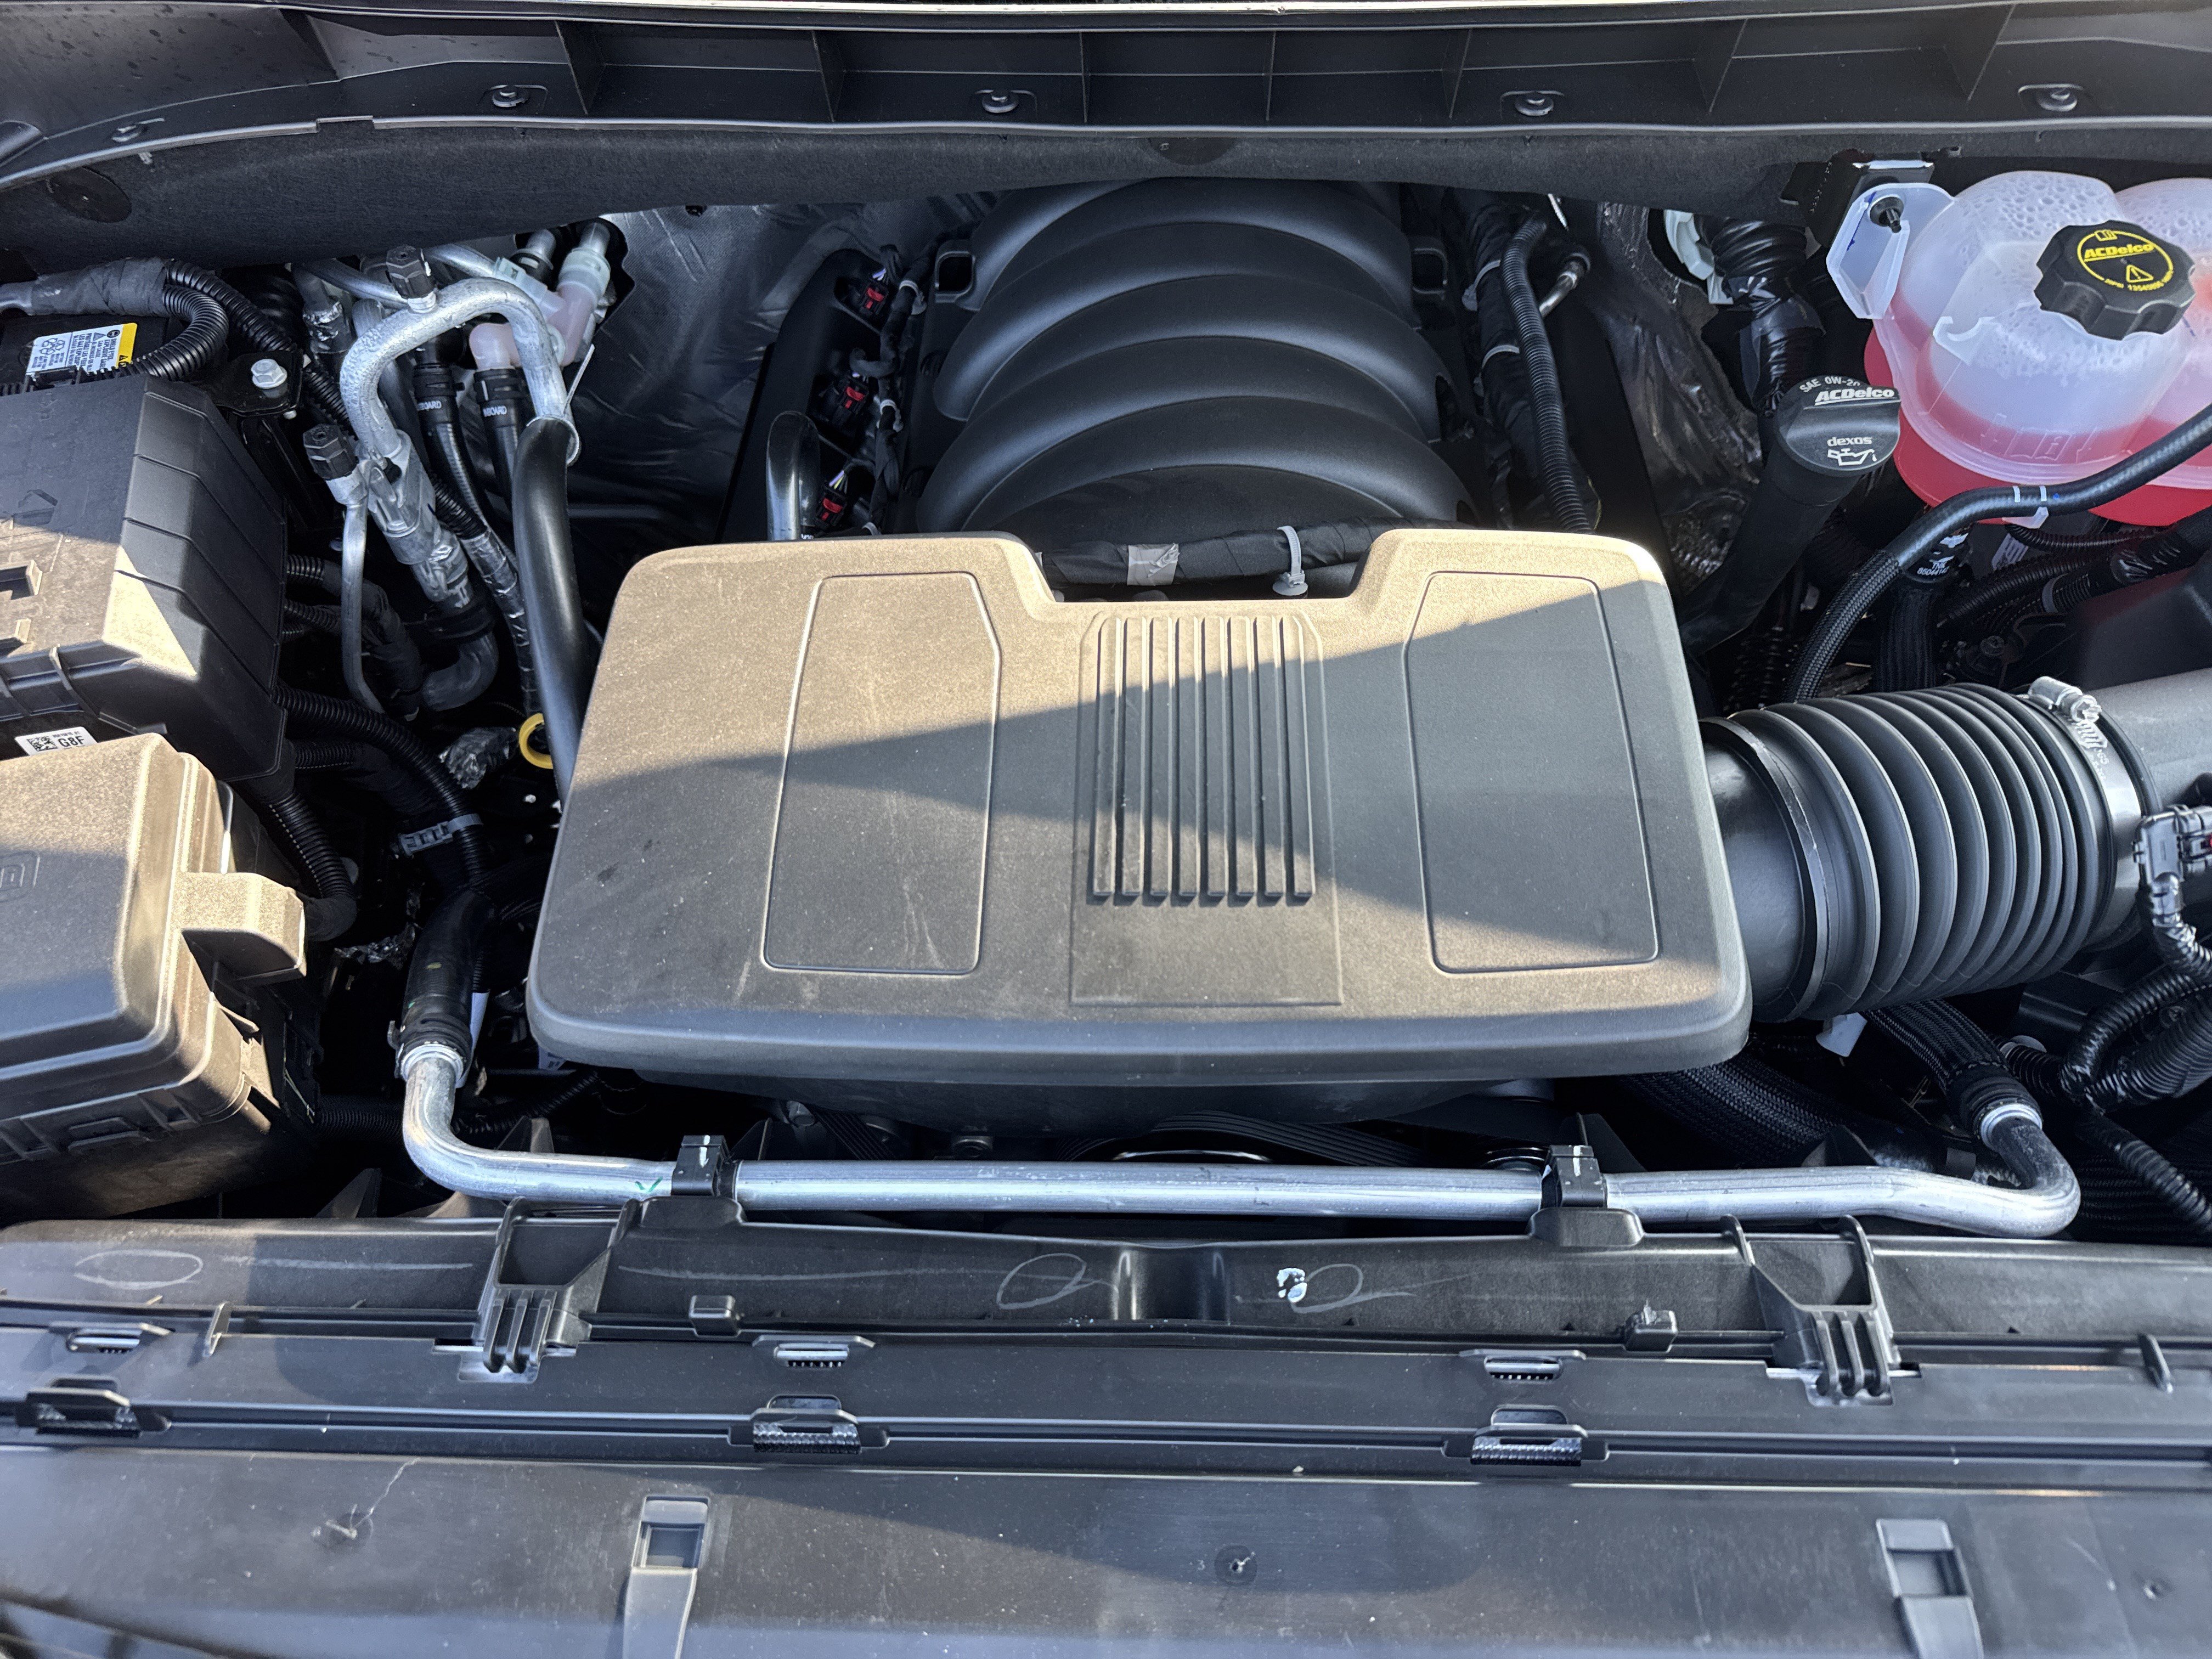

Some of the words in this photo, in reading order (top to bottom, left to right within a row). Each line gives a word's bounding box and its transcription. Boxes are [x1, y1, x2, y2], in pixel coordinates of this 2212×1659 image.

[2085, 244, 2154, 259] ACDelco
[1799, 378, 1821, 393] SAE
[1815, 387, 1894, 402] ACDelco
[1827, 437, 1872, 447] dexos
[58, 735, 84, 747] G8F
